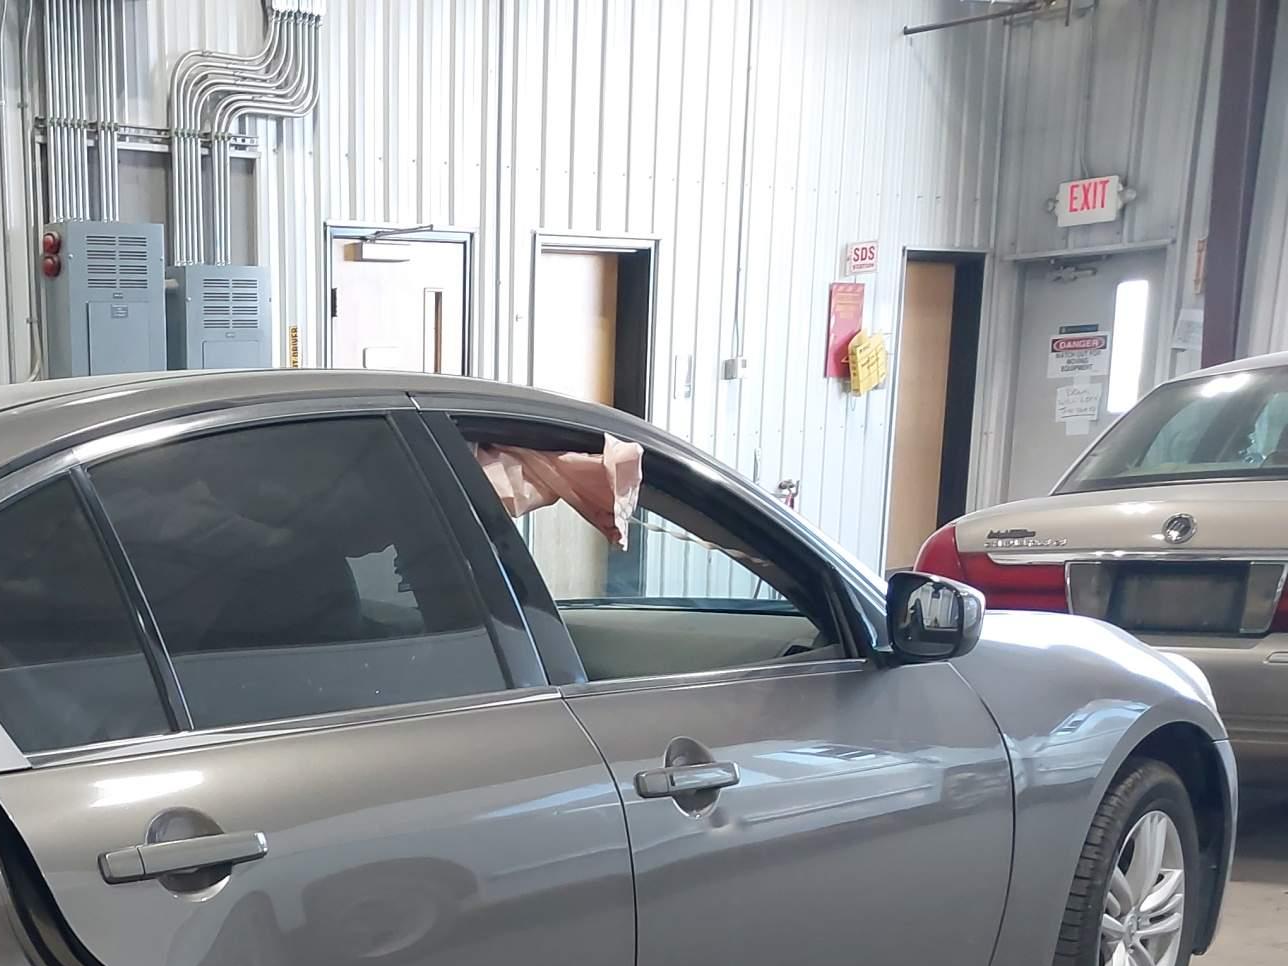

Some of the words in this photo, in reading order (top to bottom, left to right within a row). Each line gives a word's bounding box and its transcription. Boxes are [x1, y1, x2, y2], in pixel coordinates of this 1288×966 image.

[1068, 179, 1110, 213] EXIT
[852, 245, 876, 262] SDS
[1058, 340, 1099, 350] DANGER
